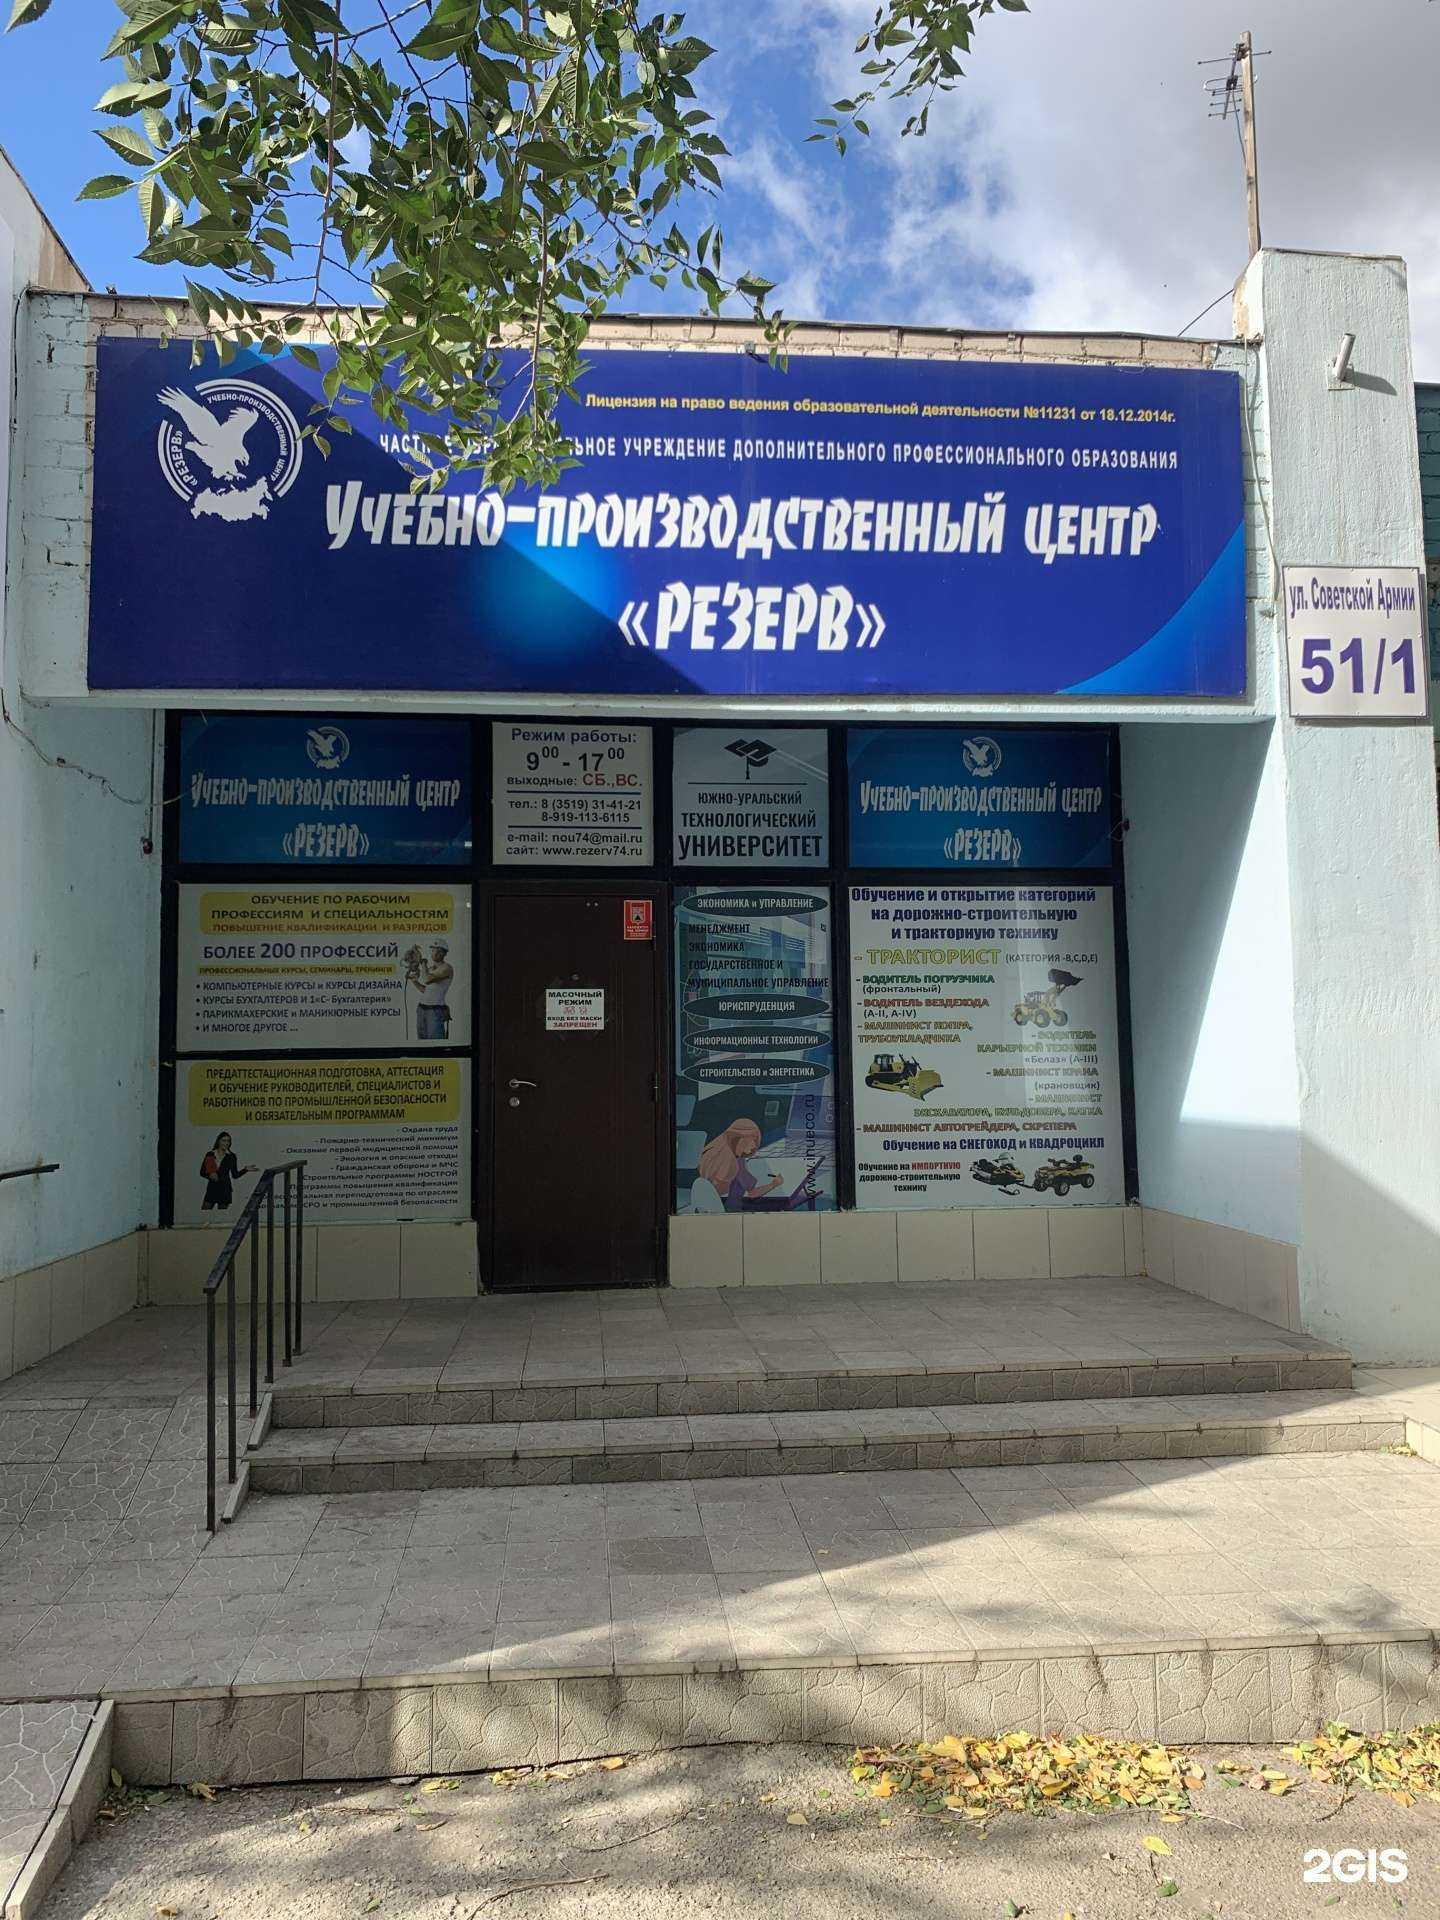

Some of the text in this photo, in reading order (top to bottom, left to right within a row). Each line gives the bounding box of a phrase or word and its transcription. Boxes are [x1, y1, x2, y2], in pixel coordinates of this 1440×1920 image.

[586, 394, 1176, 423] Лицензия на право ведения образовательной деятельности №11231 от 18.12.2014г.
[207, 392, 288, 482] УЧЕБНО-ПРОИЗВОДСТВЕННЫЙ ЦЕНТР
[171, 430, 198, 487] «РЕЗЕРВ»
[624, 437, 726, 460] УЧРЕЖДЕНИЕ
[733, 440, 885, 462] ДОПОЛНИТЕЛЬНОГО
[893, 443, 1064, 467] ПРОФЕССИОНАЛЬНОГО
[1072, 448, 1177, 469] ОБРАЗОВАНИЯ
[1025, 502, 1157, 564] ЦЕНТР
[1289, 577, 1415, 619] ул. Советской Армии
[618, 582, 886, 651] «РЕЗЕРВ»
[1301, 637, 1415, 694] 51/1
[511, 728, 637, 746] Режим работы:
[506, 776, 577, 788] выходные:
[415, 778, 461, 812] ЦЕНТР
[698, 791, 802, 806] ЮЖНО-УРАЛЬСКИЙ
[1061, 785, 1103, 817] ЦЕНТР
[508, 799, 642, 811] тел.: 8 (3519) 31-41-21
[541, 811, 630, 823] 8-919-113-6115
[681, 808, 817, 828] ТЕХНОЛОГИЧЕСКИЙ
[283, 822, 369, 857] «РЕЗЕРВ»
[507, 832, 643, 845] e-mail: nou74@mail.ru
[943, 828, 1022, 861] «РЕЗЕРВ»
[506, 845, 643, 856] сайт: www.rezerv74.ru
[678, 834, 823, 860] УНИВЕРСИТЕТ
[251, 895, 411, 905] ОБУЧЕНИЕ ПО РАБОЧИМ
[851, 887, 1096, 902] Обучение и открытие категорий
[697, 898, 814, 909] ЭКОНОМИКА УПРАВЛЕНИЕ
[211, 909, 449, 920] ПРОФЕССИЯМ И СПЕЦИАЛЬНОСТЯМ
[871, 908, 1078, 922] на дорожно-строительную
[212, 923, 284, 933] ПОВЫШЕНИЕ
[287, 923, 377, 933] КВАЛИФИКАЦИИ
[688, 923, 750, 934] МЕНЕДЖМЕНТ
[891, 927, 1059, 941] и тракторную технику
[203, 942, 399, 959] БОЛЕЕ 200 ПРОФЕССИЙ
[688, 941, 745, 952] ЭКОНОМИКА
[866, 949, 1001, 965] ТРАКТОРИСТ
[689, 959, 775, 972] ГОСУДАРСТВЕННОЕ
[203, 979, 403, 991] КОМПЬЮТЕРНЫЕ КУРСЫ КУРСЫ ДИЗАЙНА
[687, 977, 829, 990] МУНИЦИПАЛЬНОЕ УПРАВЛЕНИЕ
[863, 975, 995, 985] ВОДИТЕЛЬ ПОГРУЗЧИКА
[862, 984, 942, 994] (фронтальный)
[203, 995, 234, 1005] КУРСЫ
[237, 995, 299, 1004] БУХГАЛТЕРОВ
[864, 998, 923, 1008] ВОДИТЕЛЬ
[203, 1008, 401, 1018] ПАРИКМАХЕРСКИЕ МАНИКЮРНЫЕ КУРСЫ
[719, 1001, 795, 1013] ЮРИСПРУДЕНЦИЯ
[211, 1023, 251, 1032] МНОГОЕ
[253, 1023, 287, 1034] ДРУГОЕ
[693, 1035, 819, 1047] ИНФОРМАЦИОННЫЕ ТЕХНОЛОГИИ
[206, 1067, 317, 1080] ПРЕДАТТЕСТАЦИОННАЯ
[386, 1065, 444, 1078] АТТЕСТАЦИЯ
[699, 1067, 815, 1077] СТРОИТЕЛЬСТВО ЭНЕРГЕТИКА
[209, 1083, 217, 1093] И
[219, 1082, 268, 1093] ОБУЧЕНИЕ
[356, 1080, 432, 1093] СПЕЦИАЛИСТОВ
[433, 1080, 441, 1089] И
[203, 1093, 447, 1107] РАБОТНИКОВ ПО ПРОМЫШЛЕННОЙ БЕЗОПАСНОСТИ
[245, 1108, 406, 1120] И ОБЯЗАТЕЛЬНЫМ ПРОГРАММАМ
[863, 1122, 931, 1133] МАШИНИСТ
[1022, 1121, 1077, 1132] СКРЕПЕРА
[882, 1137, 1105, 1152] Обучение на СНЕГОХОД и КВАДРОЦИКЛ
[858, 1161, 961, 1172] Обучение на ИМПОРТНУЮ
[859, 1173, 961, 1184] дорожно-строительную
[893, 1183, 928, 1193] технику
